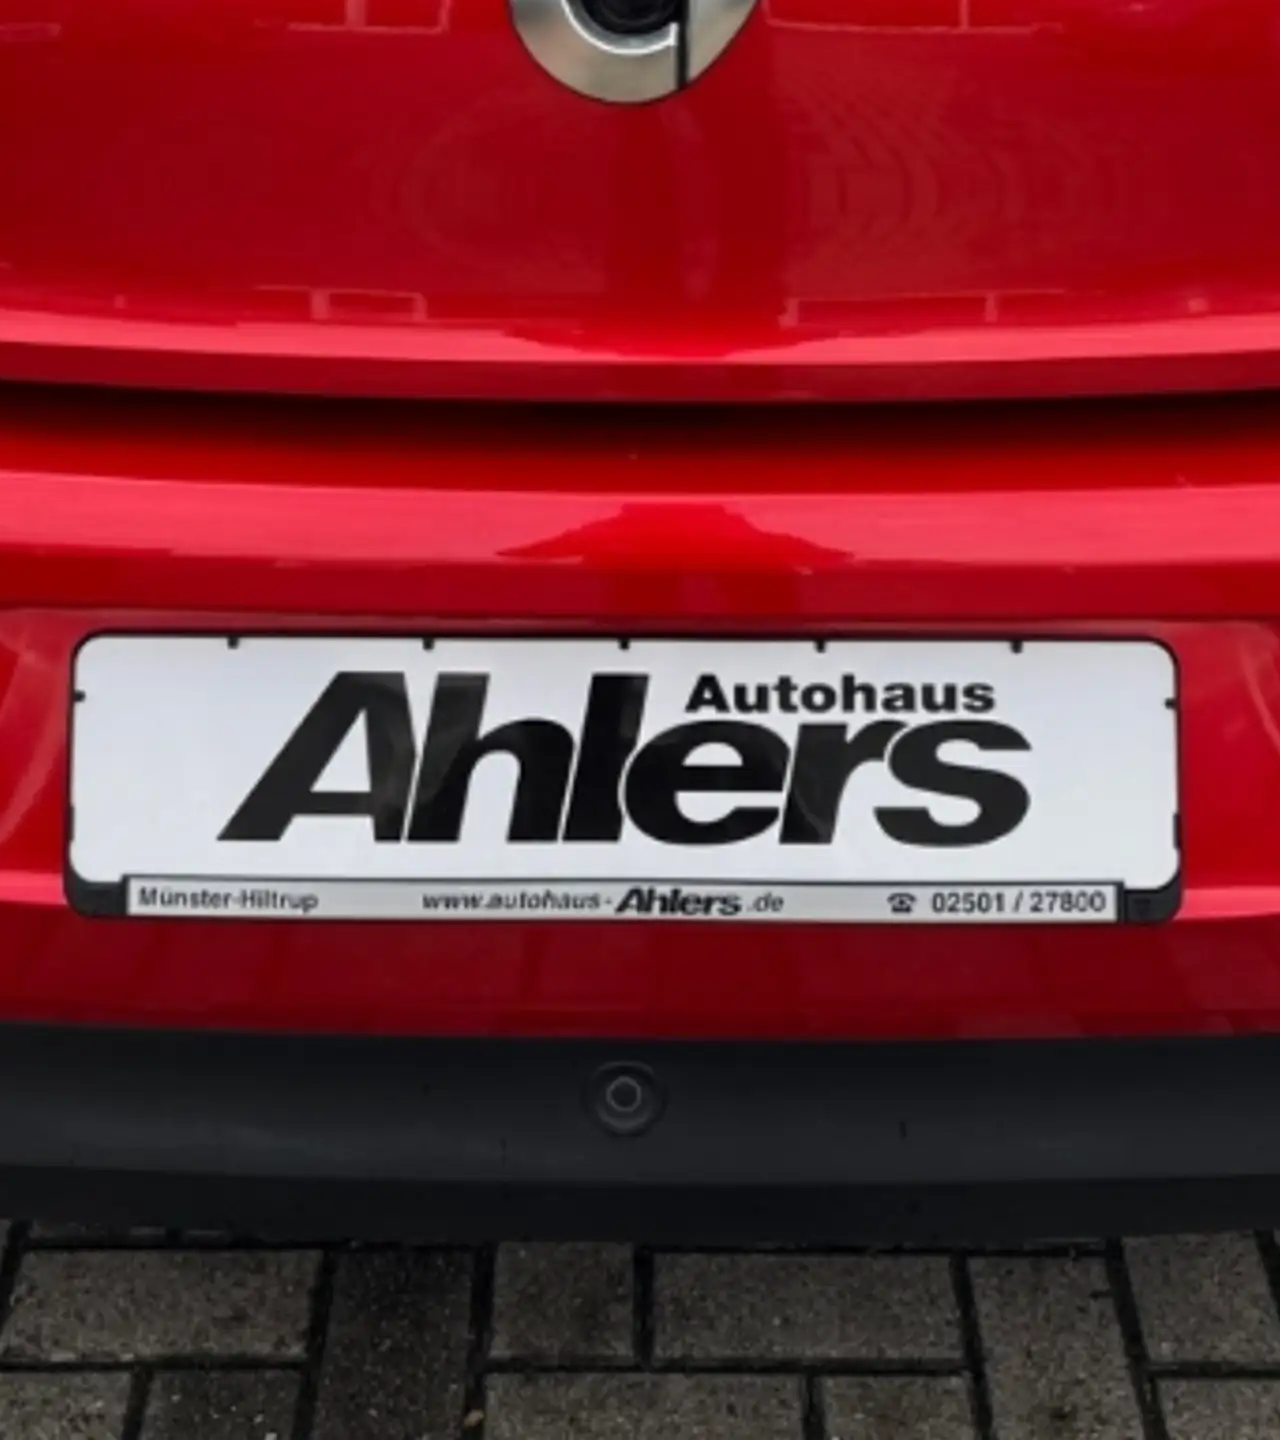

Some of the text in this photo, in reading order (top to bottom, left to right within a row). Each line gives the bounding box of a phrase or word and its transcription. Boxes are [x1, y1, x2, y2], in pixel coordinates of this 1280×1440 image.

[684, 673, 997, 714] Autohaus
[216, 670, 1033, 848] Ahlers
[137, 886, 320, 914] Münster-Hiltrup
[931, 891, 1006, 913] 02501
[1028, 890, 1107, 914] 27800
